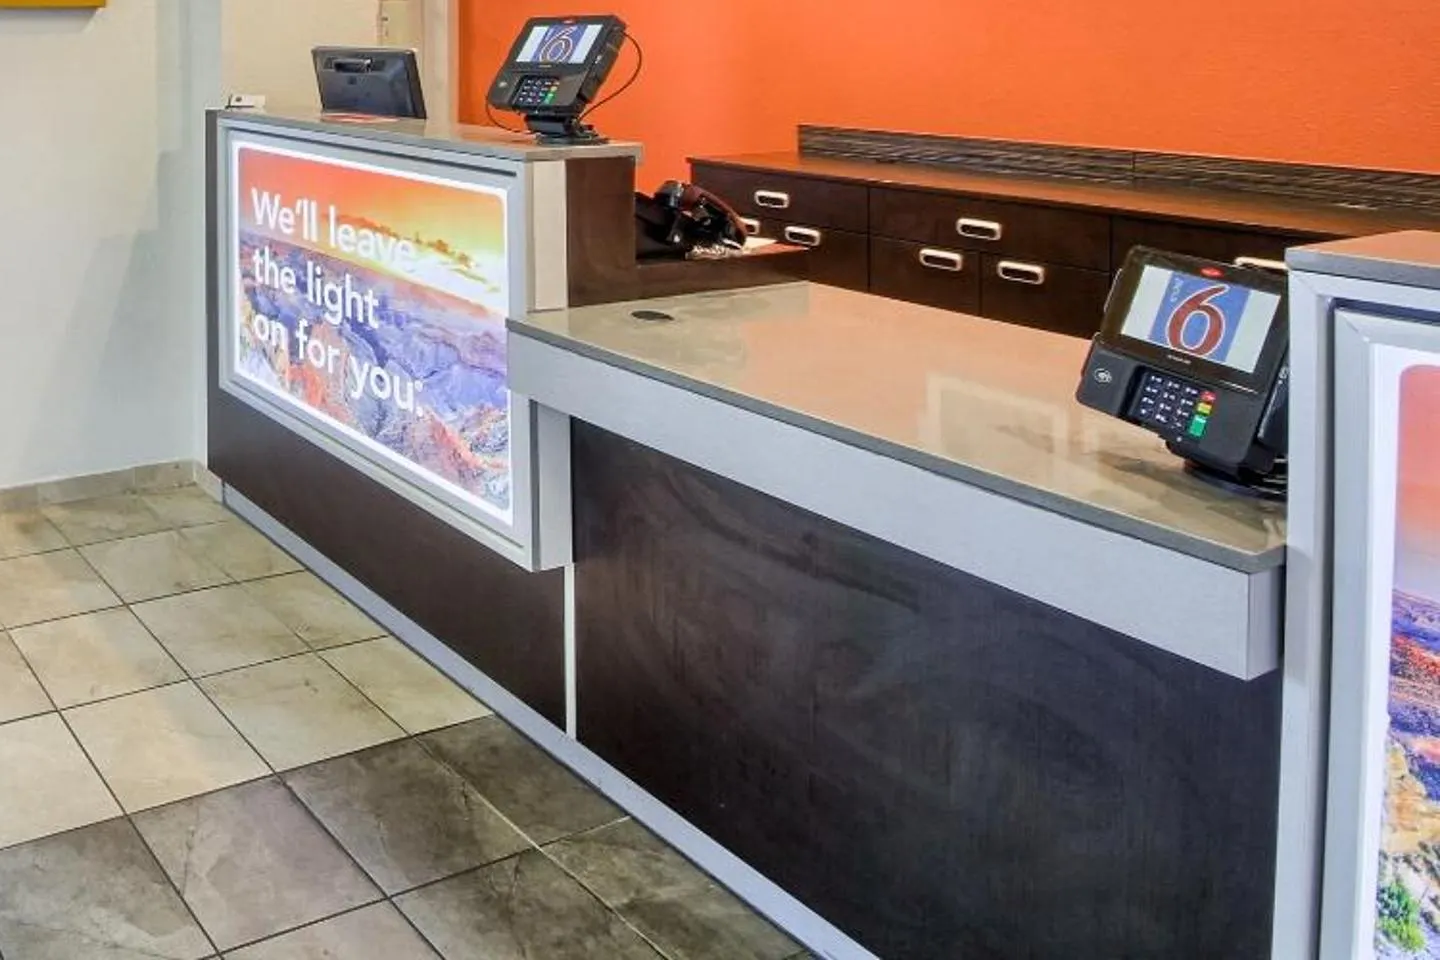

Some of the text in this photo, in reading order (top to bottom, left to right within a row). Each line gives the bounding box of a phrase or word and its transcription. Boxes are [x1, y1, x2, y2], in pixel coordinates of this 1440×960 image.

[251, 186, 415, 274] We'll leave
[253, 245, 380, 329] the light
[1165, 283, 1230, 357] 6
[254, 314, 289, 350] on
[296, 317, 340, 374] for
